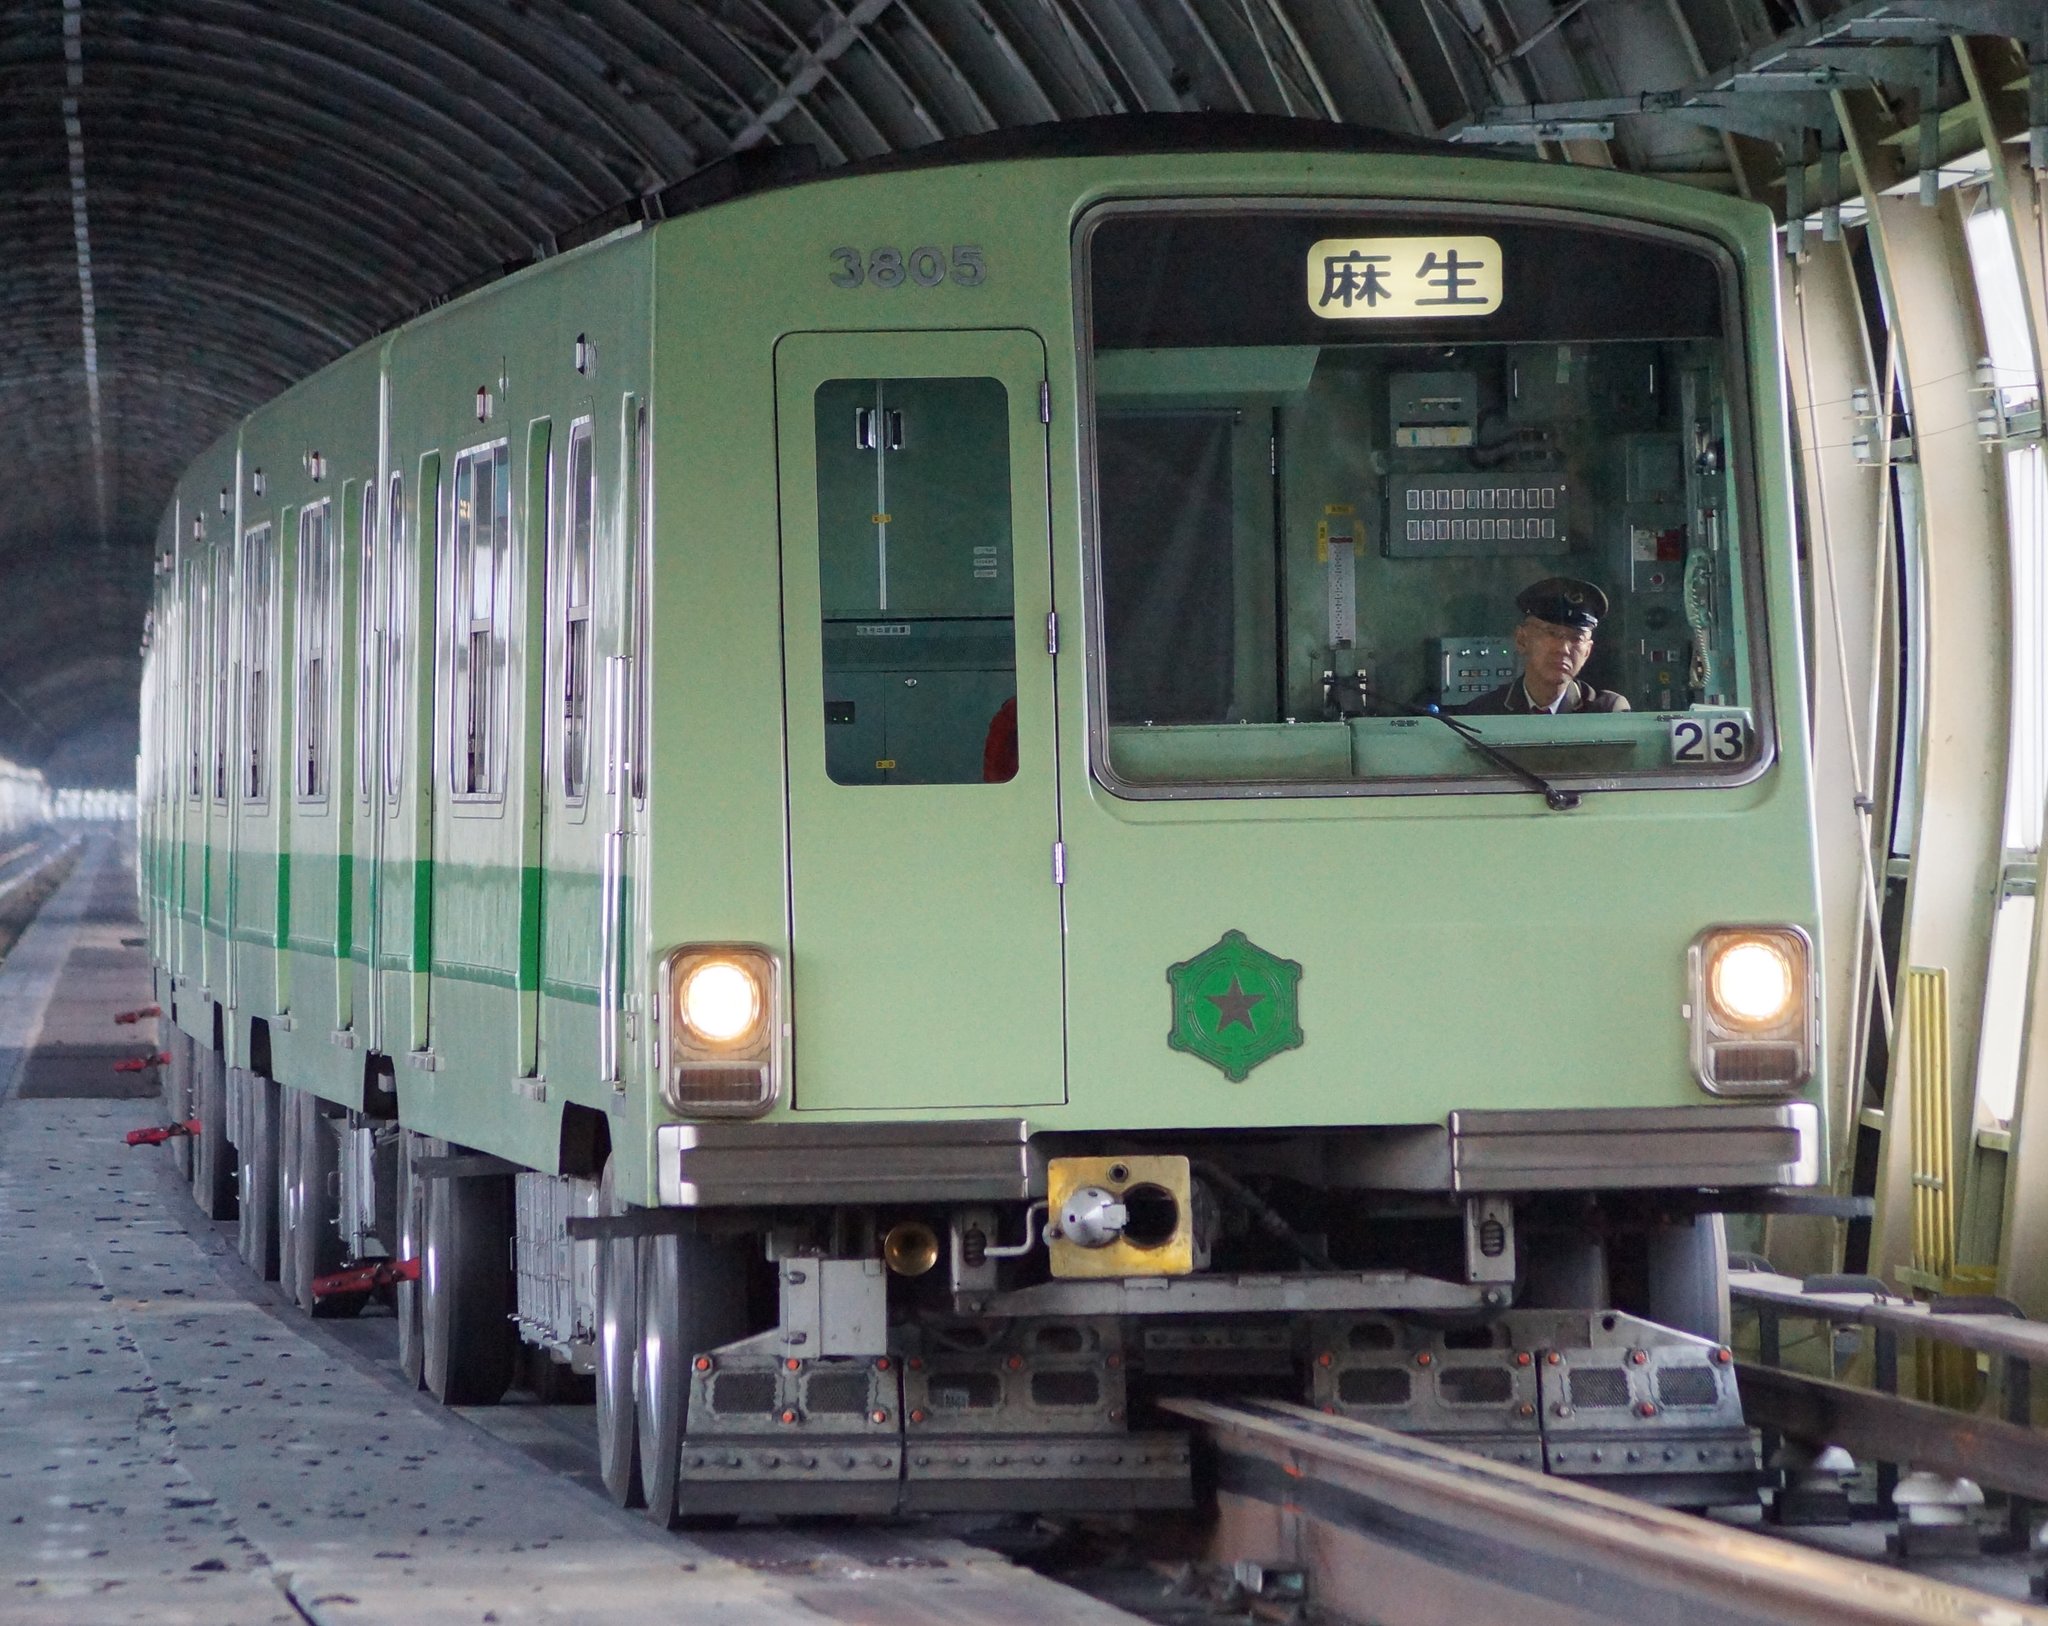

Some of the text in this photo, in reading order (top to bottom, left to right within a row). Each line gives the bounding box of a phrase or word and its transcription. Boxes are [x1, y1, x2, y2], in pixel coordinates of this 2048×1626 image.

[829, 245, 987, 288] 3805
[1318, 249, 1489, 308] 麻生
[1675, 721, 1743, 761] 23
